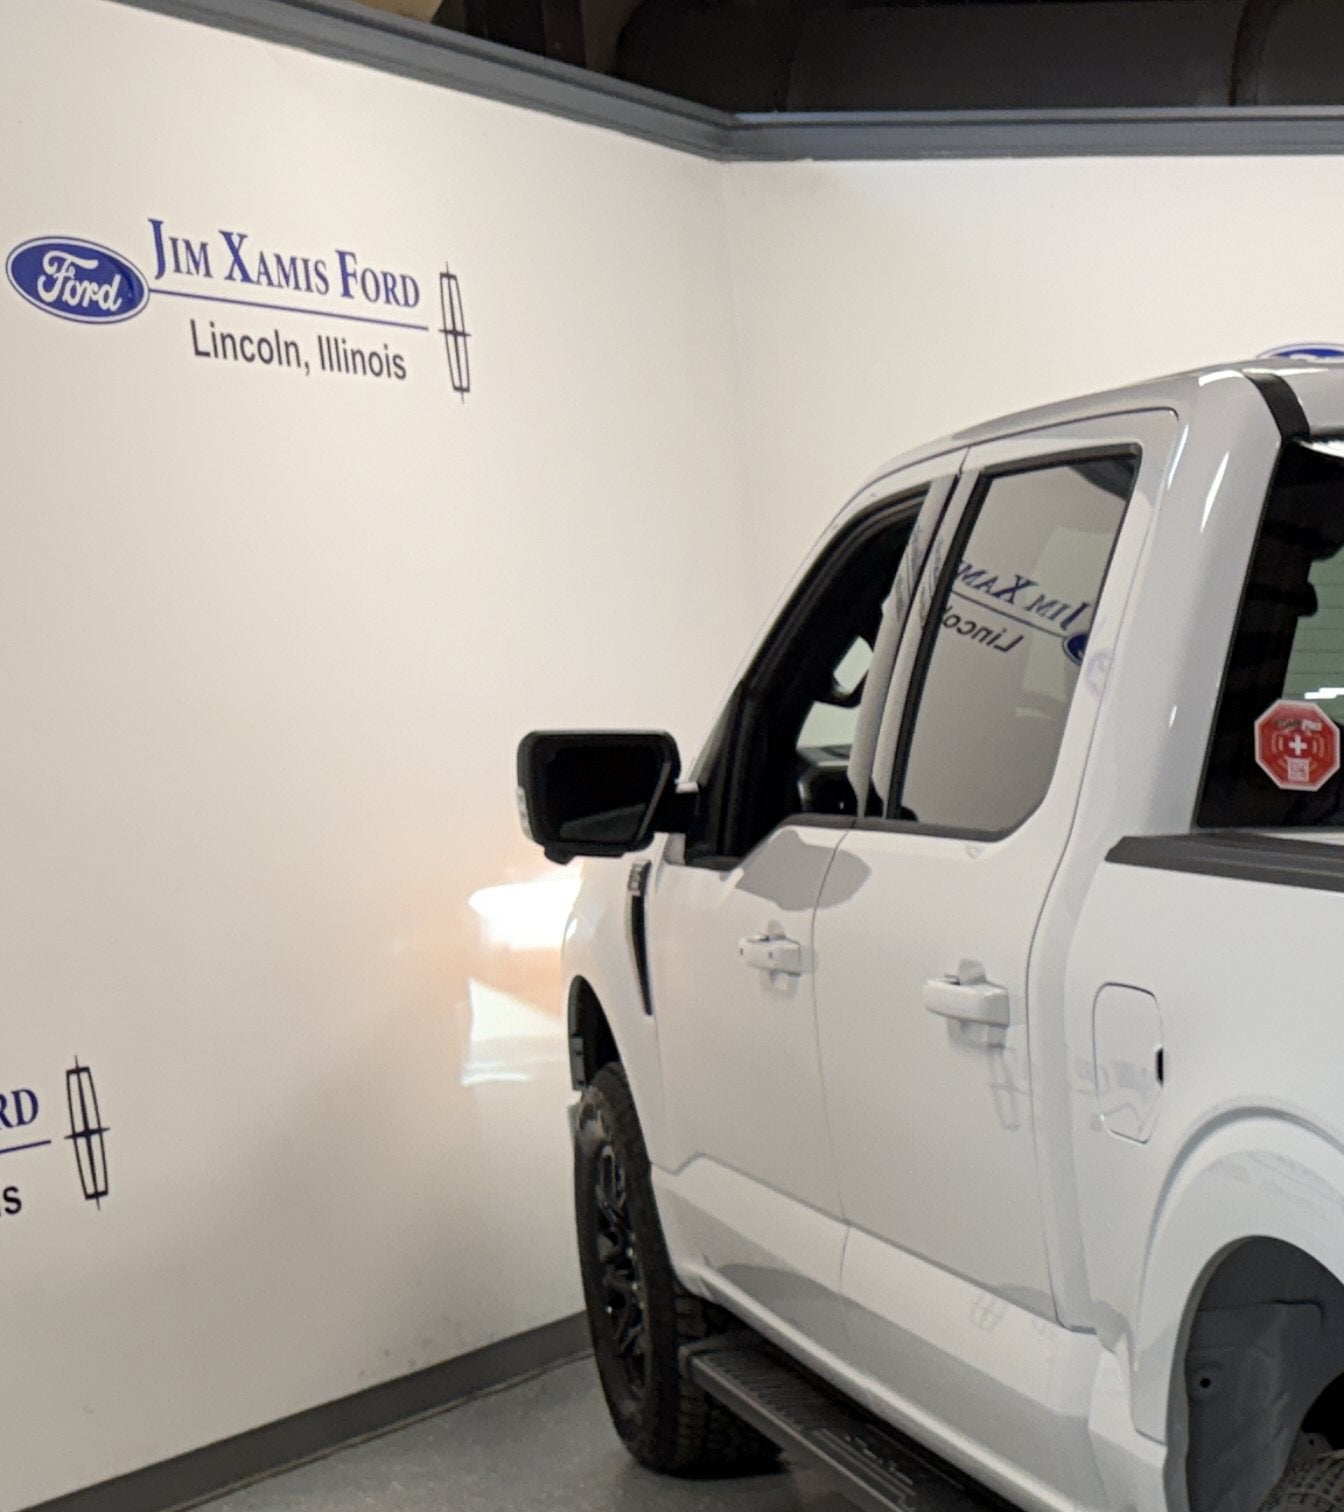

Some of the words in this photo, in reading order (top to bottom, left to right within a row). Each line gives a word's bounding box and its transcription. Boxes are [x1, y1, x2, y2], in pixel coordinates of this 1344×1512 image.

[38, 250, 122, 311] Ford
[148, 218, 213, 280] JIM
[219, 229, 329, 295] XAMIS
[335, 249, 420, 308] FORD
[190, 318, 310, 375] Lincoln,
[318, 335, 407, 379] Illinois
